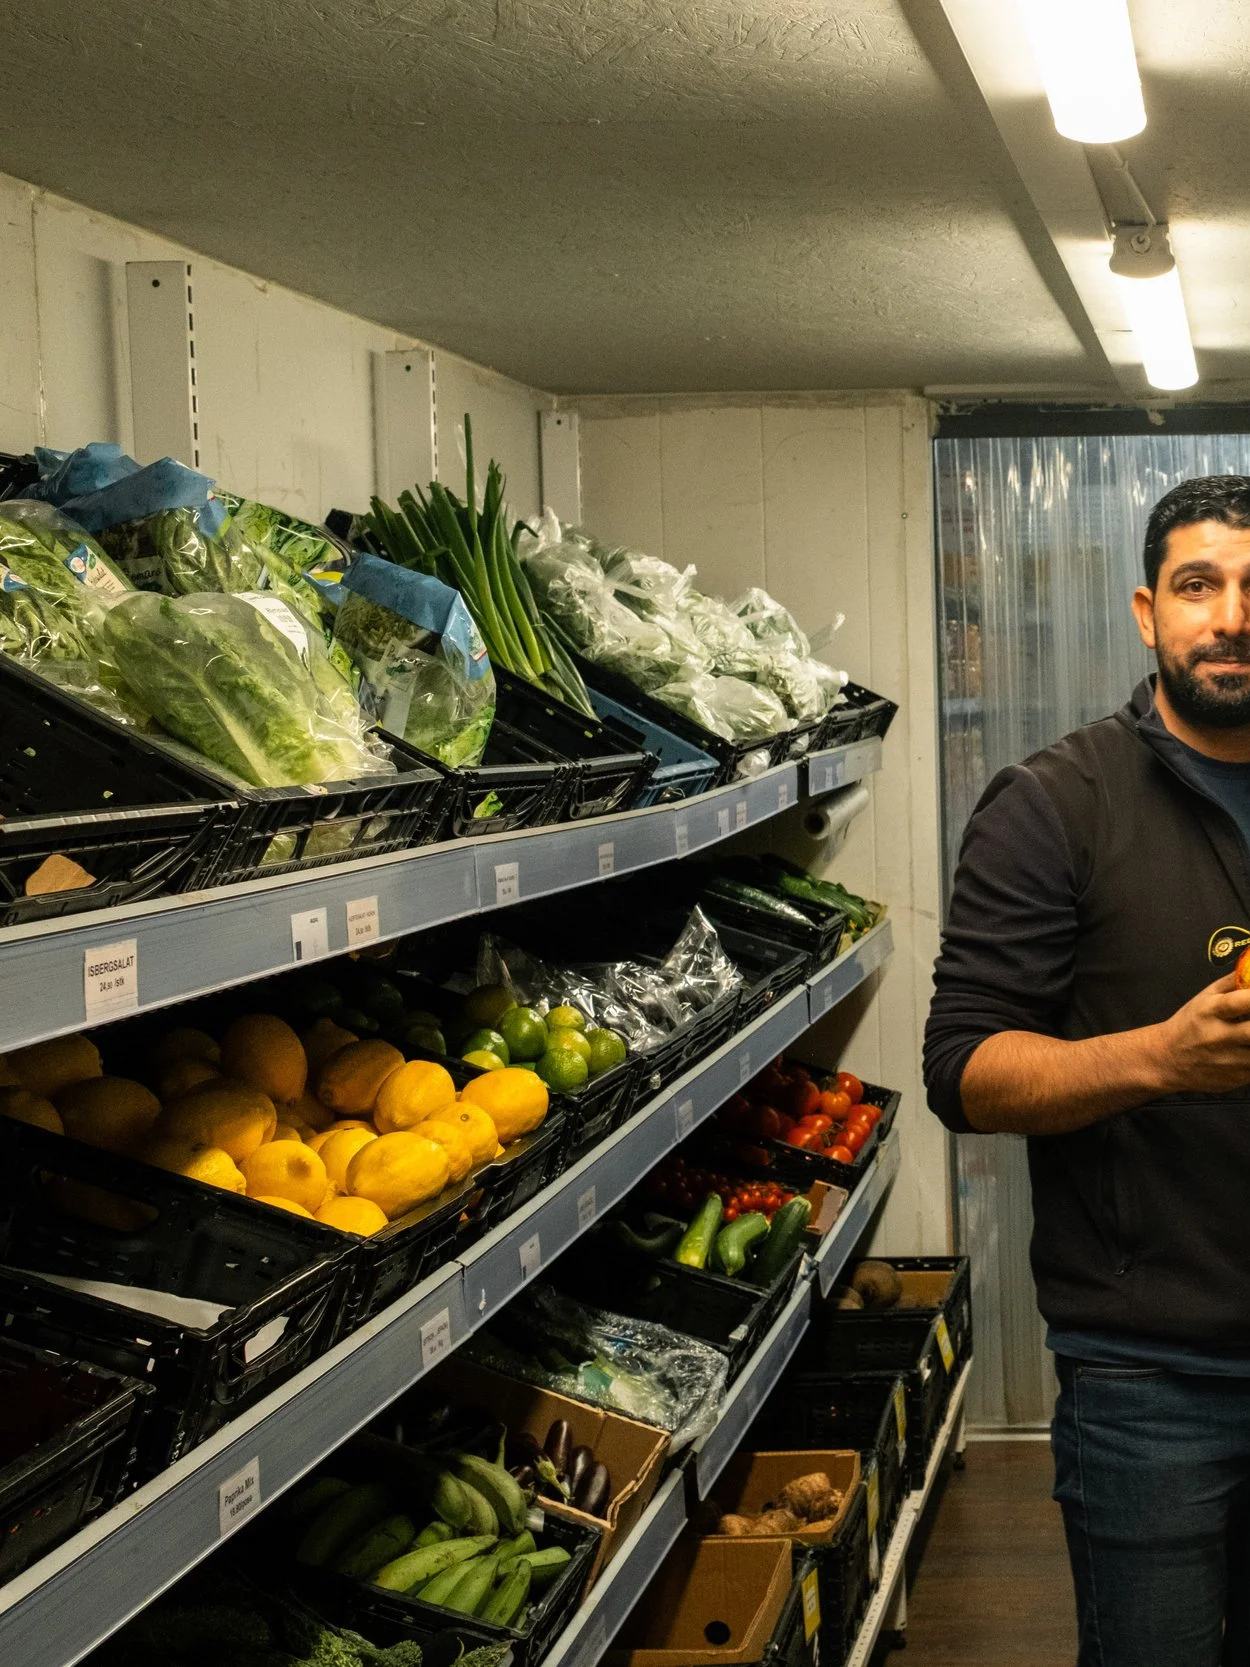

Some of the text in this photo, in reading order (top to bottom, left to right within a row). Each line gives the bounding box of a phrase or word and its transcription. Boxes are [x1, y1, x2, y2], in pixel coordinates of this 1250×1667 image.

[88, 955, 134, 978] ISBERGSALAT
[224, 1476, 255, 1507] Paprika Mix
